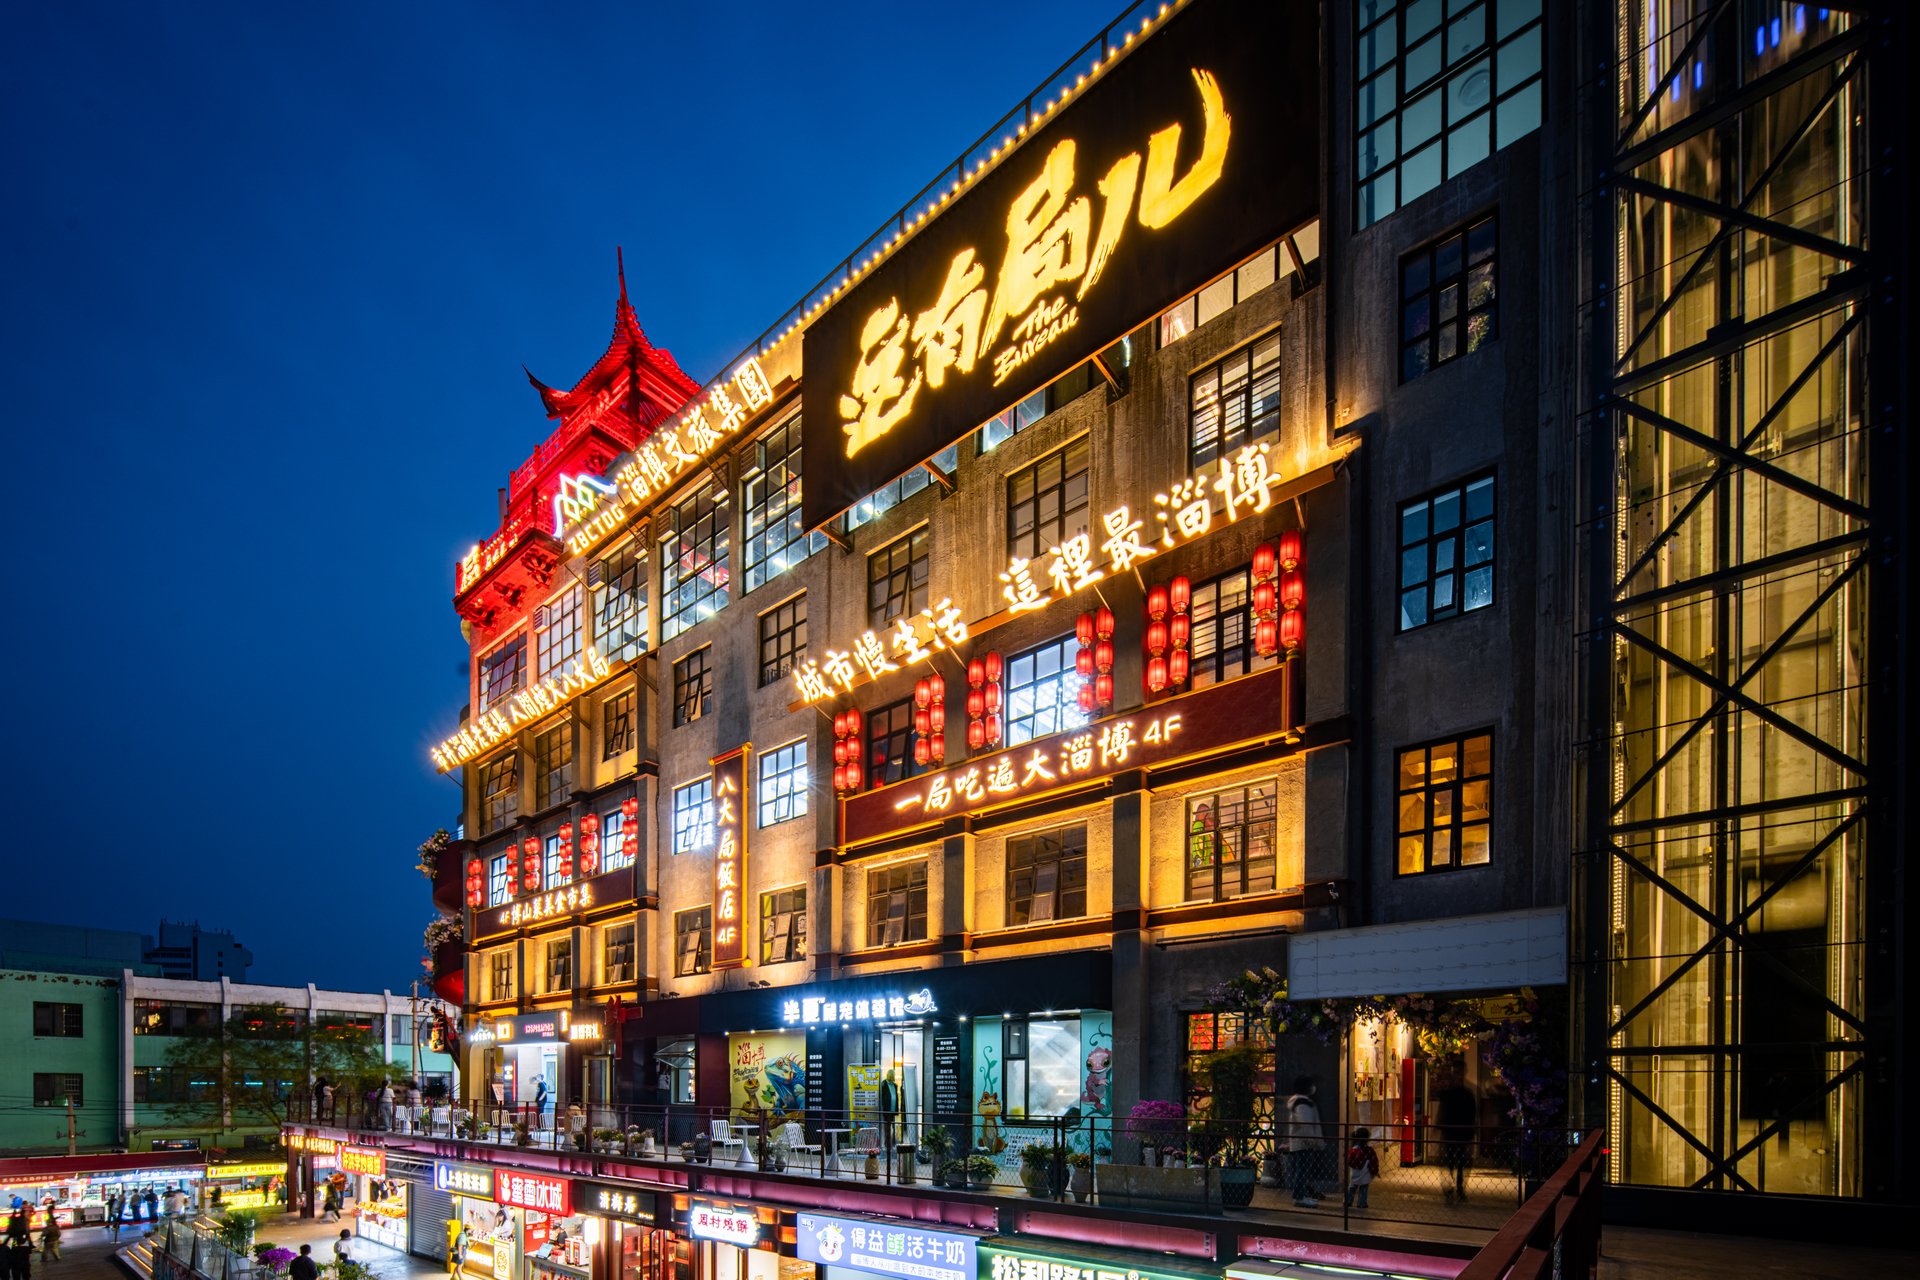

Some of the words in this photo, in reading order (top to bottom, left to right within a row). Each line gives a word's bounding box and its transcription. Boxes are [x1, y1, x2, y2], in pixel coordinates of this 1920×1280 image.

[1013, 296, 1067, 340] The
[993, 306, 1079, 387] Bureau
[622, 357, 773, 506] 淄博文旅集團
[567, 503, 626, 555] ZBCTDG
[794, 597, 971, 702] 城市慢生活
[894, 719, 1137, 812] 一局吃遍大淄博
[1143, 715, 1182, 744] 4F
[716, 776, 738, 920] 八大局飯店
[500, 911, 510, 924] 4F
[717, 928, 735, 944] 4F
[511, 1176, 562, 1211] 蜜雪冰城
[851, 1227, 965, 1265] 得益鲜活牛奶
